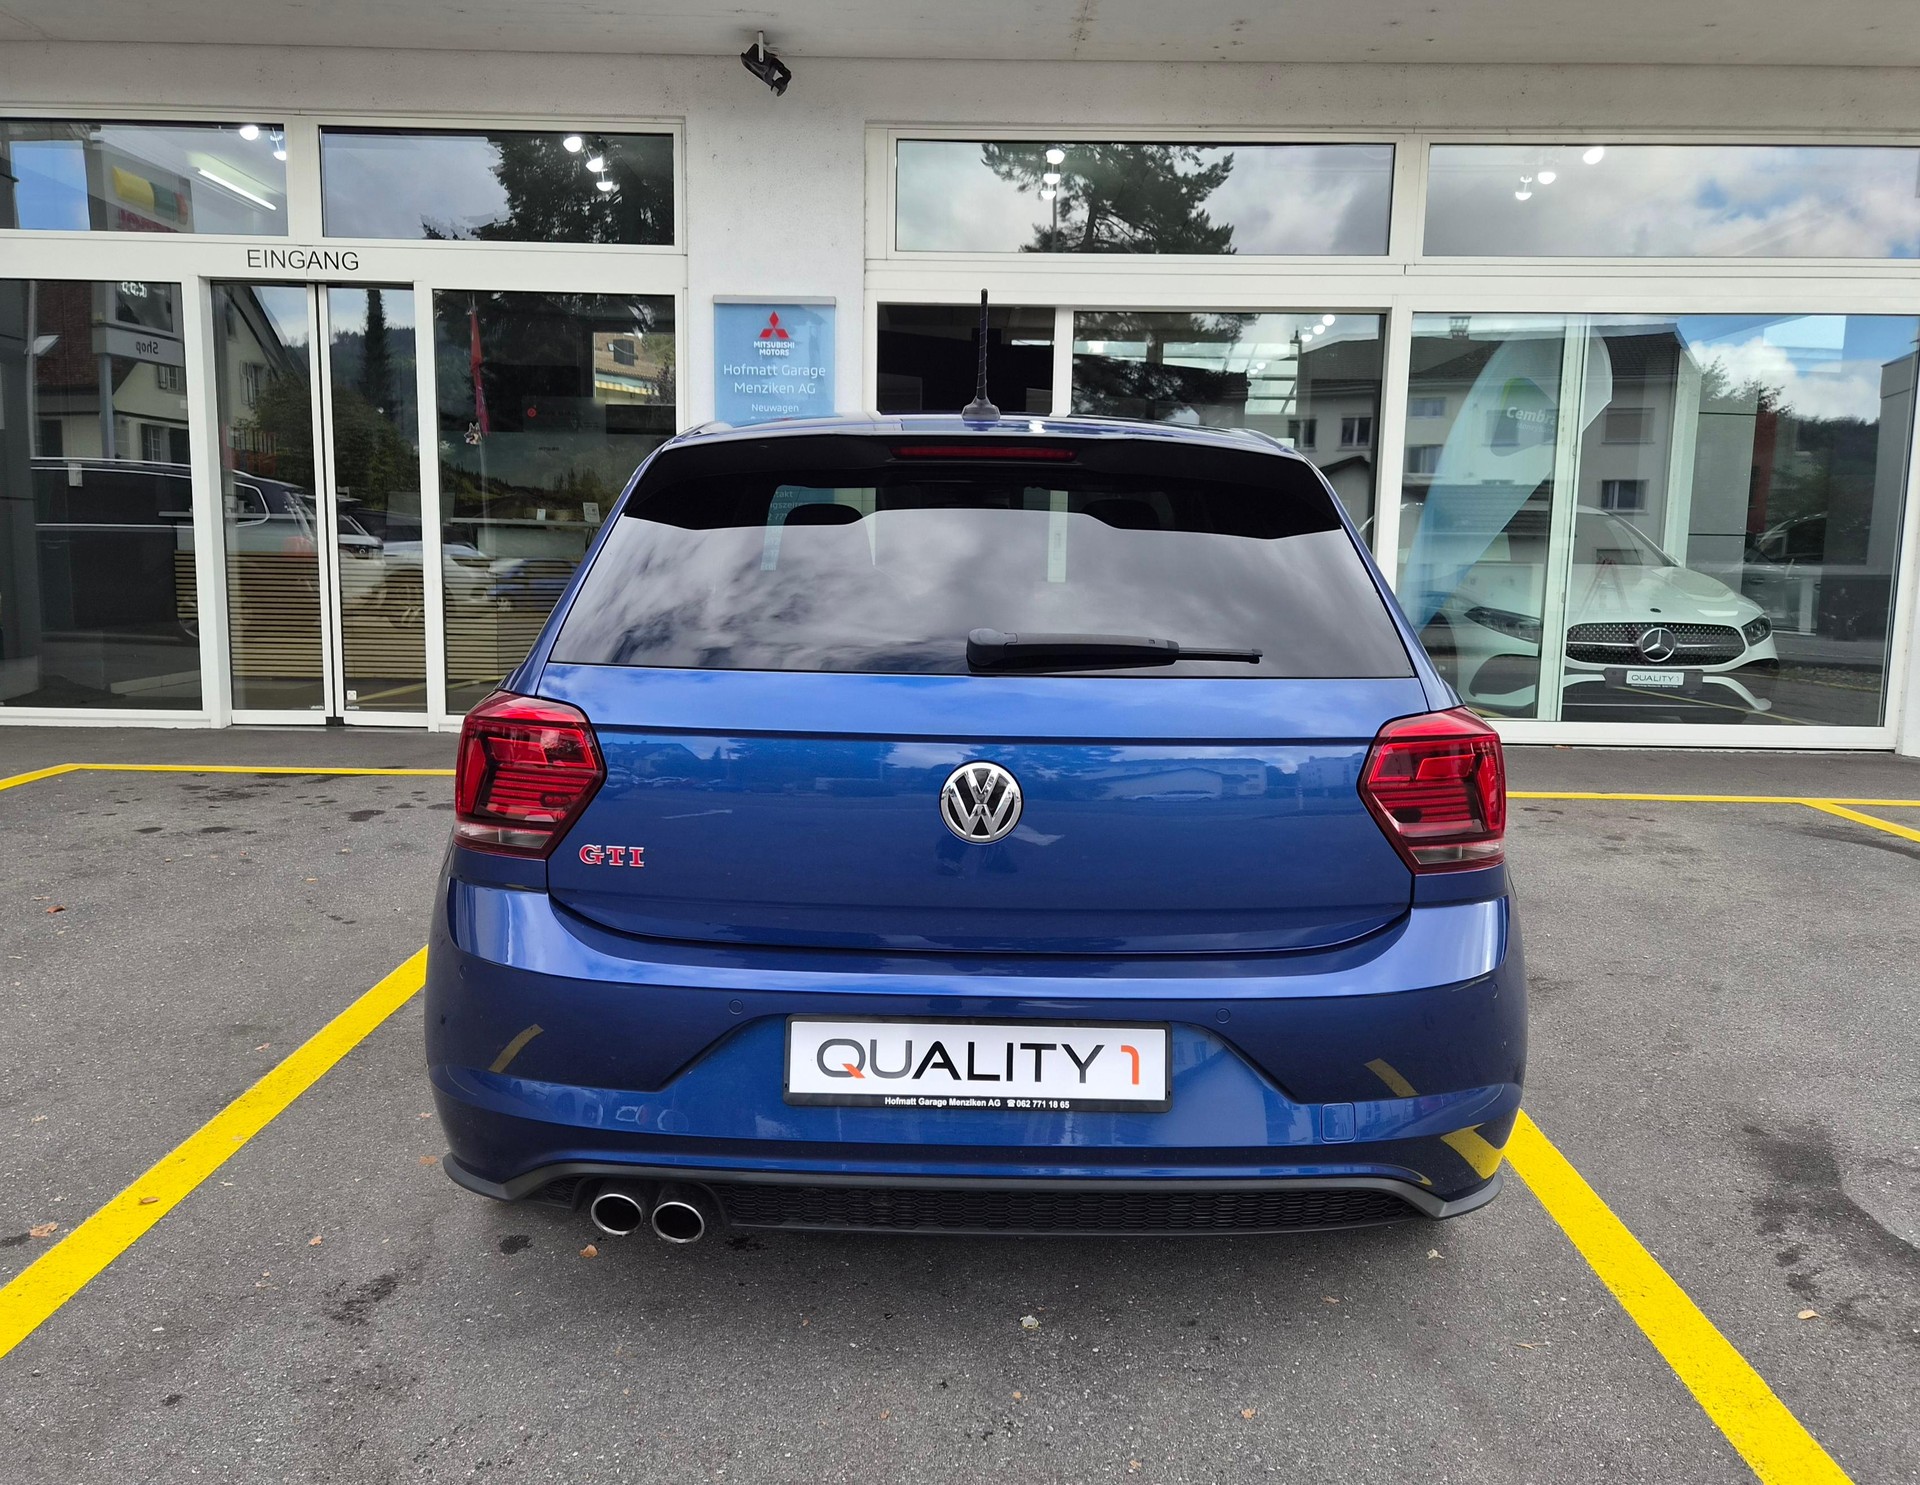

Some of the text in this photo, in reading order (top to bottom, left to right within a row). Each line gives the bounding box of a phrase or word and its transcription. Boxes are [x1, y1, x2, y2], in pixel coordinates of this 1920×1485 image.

[247, 249, 359, 271] EINGANG
[753, 341, 795, 349] MITSUBISHI
[759, 348, 790, 356] MOTORS
[723, 363, 826, 379] Hofmatt Garage
[734, 381, 816, 394] Menziken AG
[751, 403, 799, 413] Neuwagen
[1631, 674, 1674, 682] QUALITY
[579, 844, 645, 867] GTI
[817, 1038, 1140, 1085] QUALITY 1
[884, 1096, 1070, 1109] Hofmatt Garage Menziken AG 062 771 18 65
